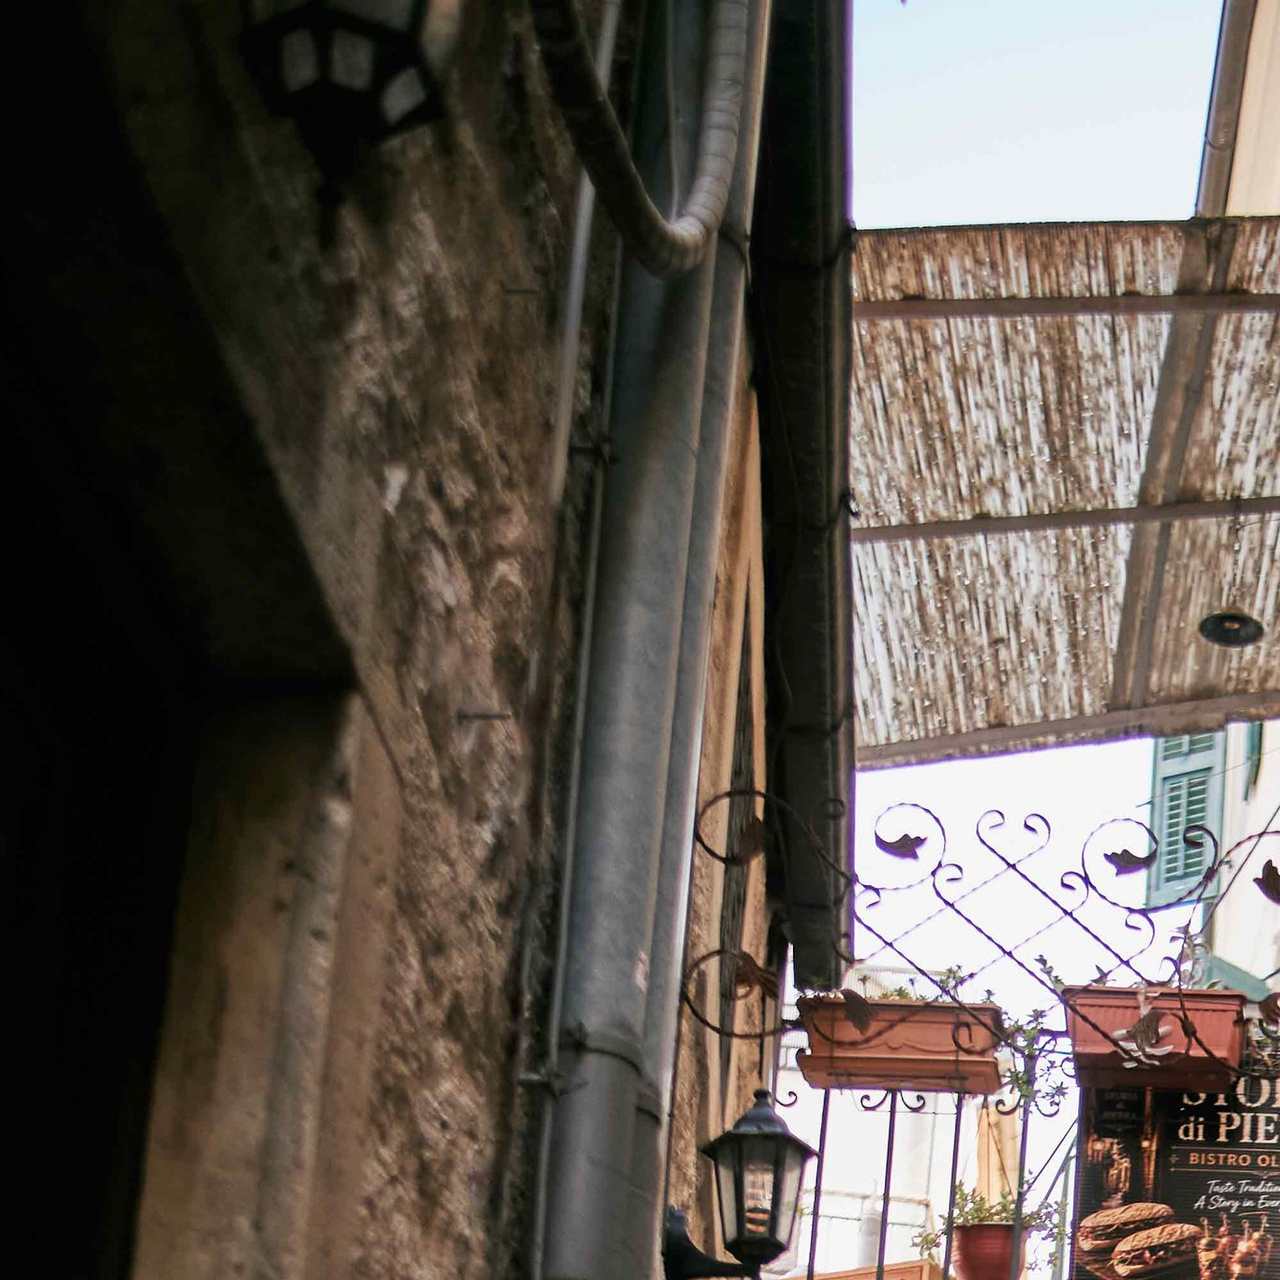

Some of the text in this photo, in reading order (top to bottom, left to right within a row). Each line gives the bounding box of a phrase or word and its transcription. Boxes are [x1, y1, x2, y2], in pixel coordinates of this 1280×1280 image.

[1178, 1115, 1206, 1141] di
[1189, 1152, 1252, 1167] BISTRO
[1206, 1179, 1237, 1194] Taste
[1193, 1195, 1206, 1210] A
[1209, 1195, 1241, 1212] Story
